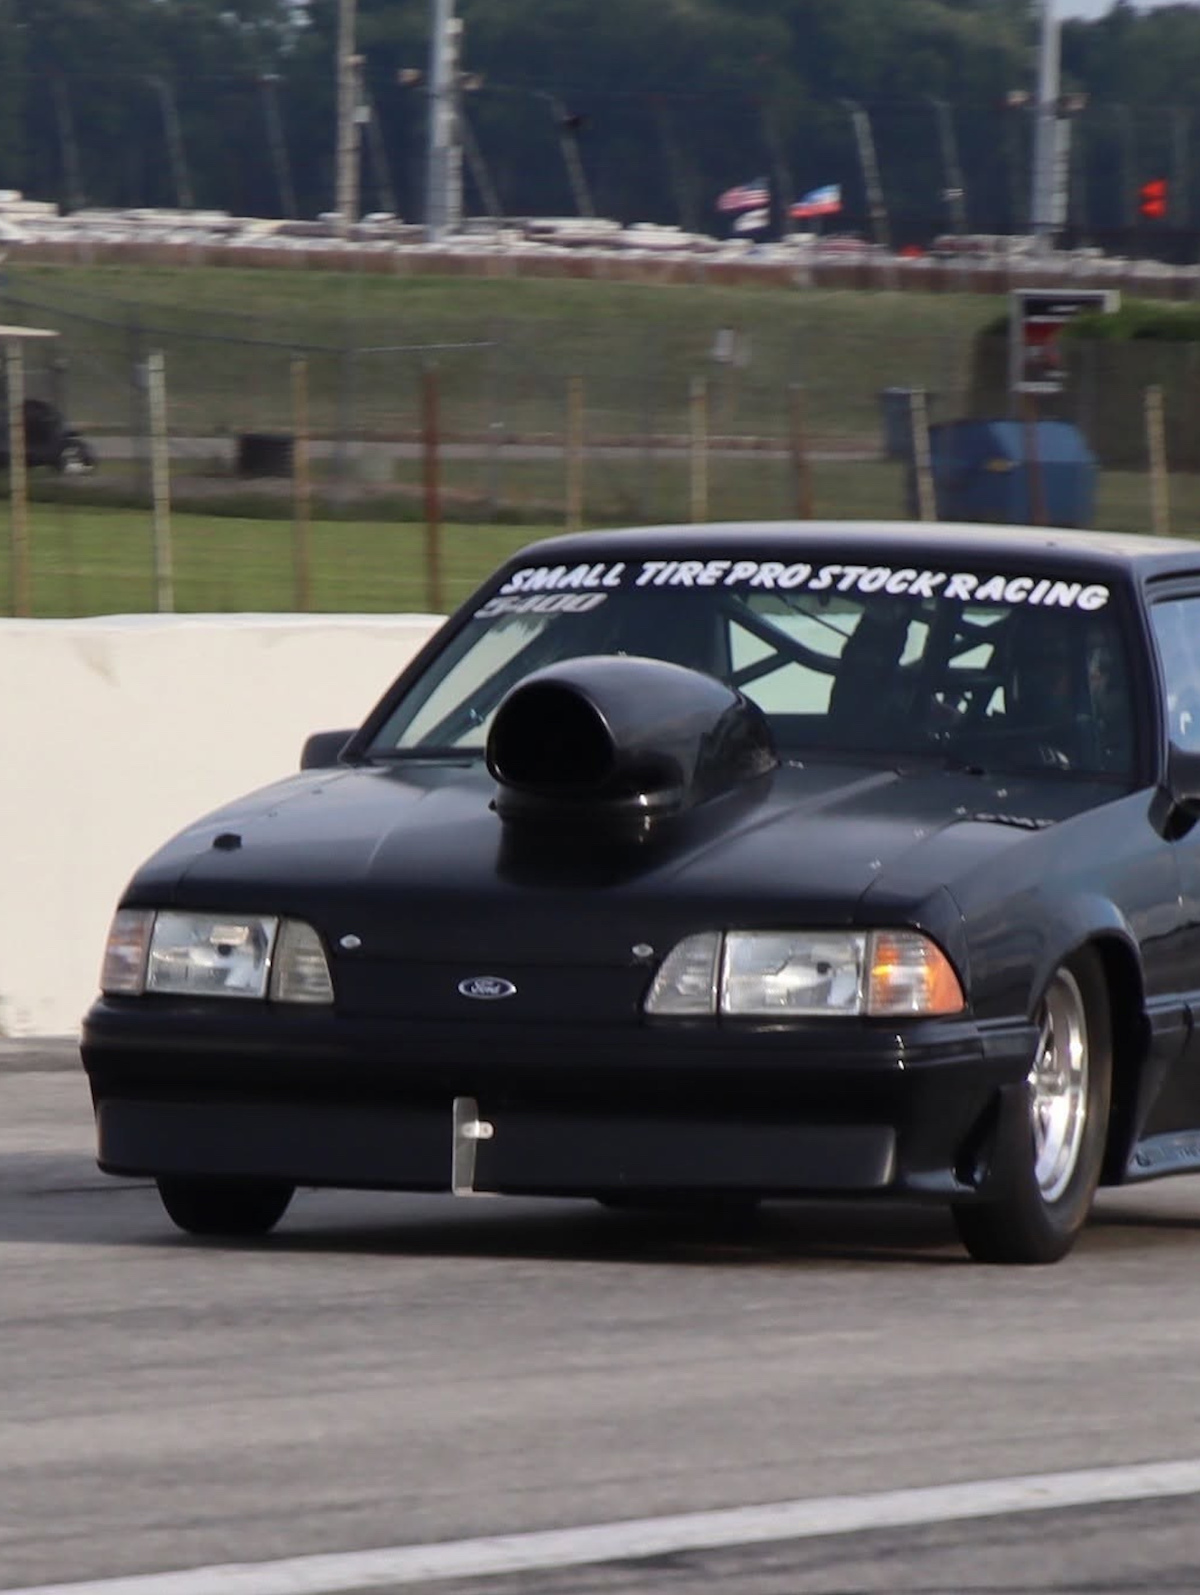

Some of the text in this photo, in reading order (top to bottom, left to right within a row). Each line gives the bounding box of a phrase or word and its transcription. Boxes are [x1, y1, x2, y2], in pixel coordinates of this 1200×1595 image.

[501, 562, 626, 594] SMALL
[635, 560, 732, 587] TIRE
[808, 565, 947, 598] STOCK
[943, 573, 1110, 611] RACING
